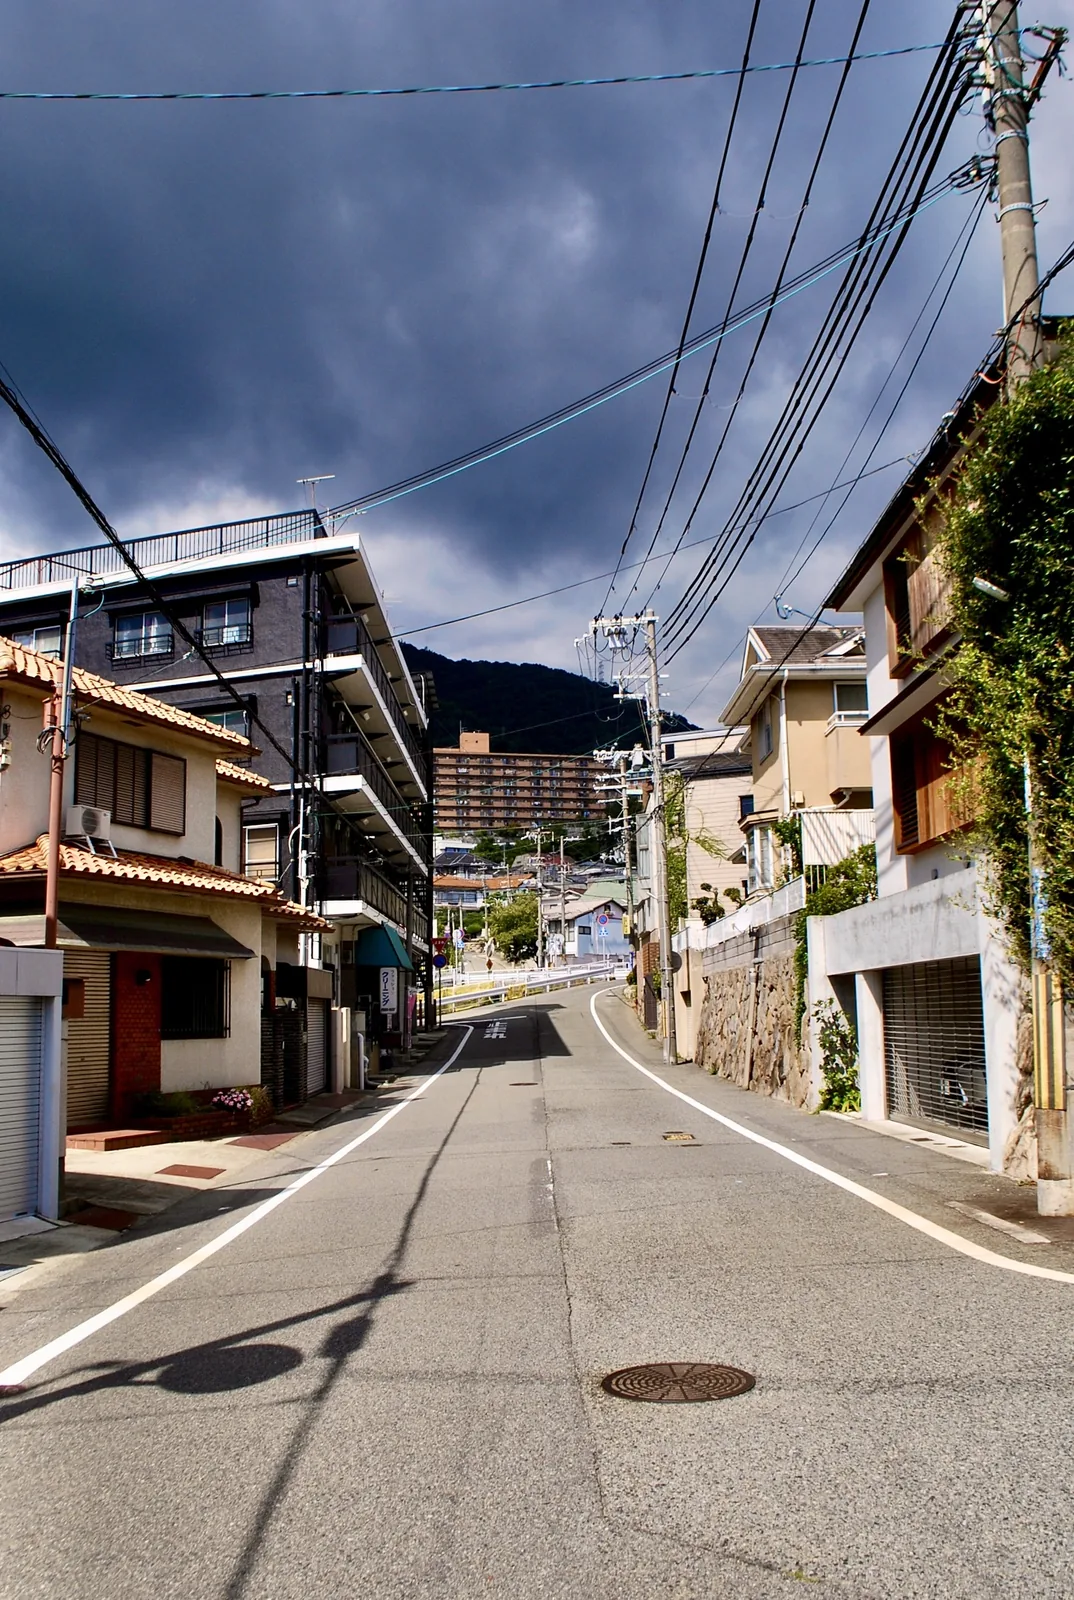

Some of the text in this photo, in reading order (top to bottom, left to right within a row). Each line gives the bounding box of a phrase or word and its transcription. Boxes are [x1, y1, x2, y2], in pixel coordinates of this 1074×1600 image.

[381, 971, 390, 1006] クリーニング
